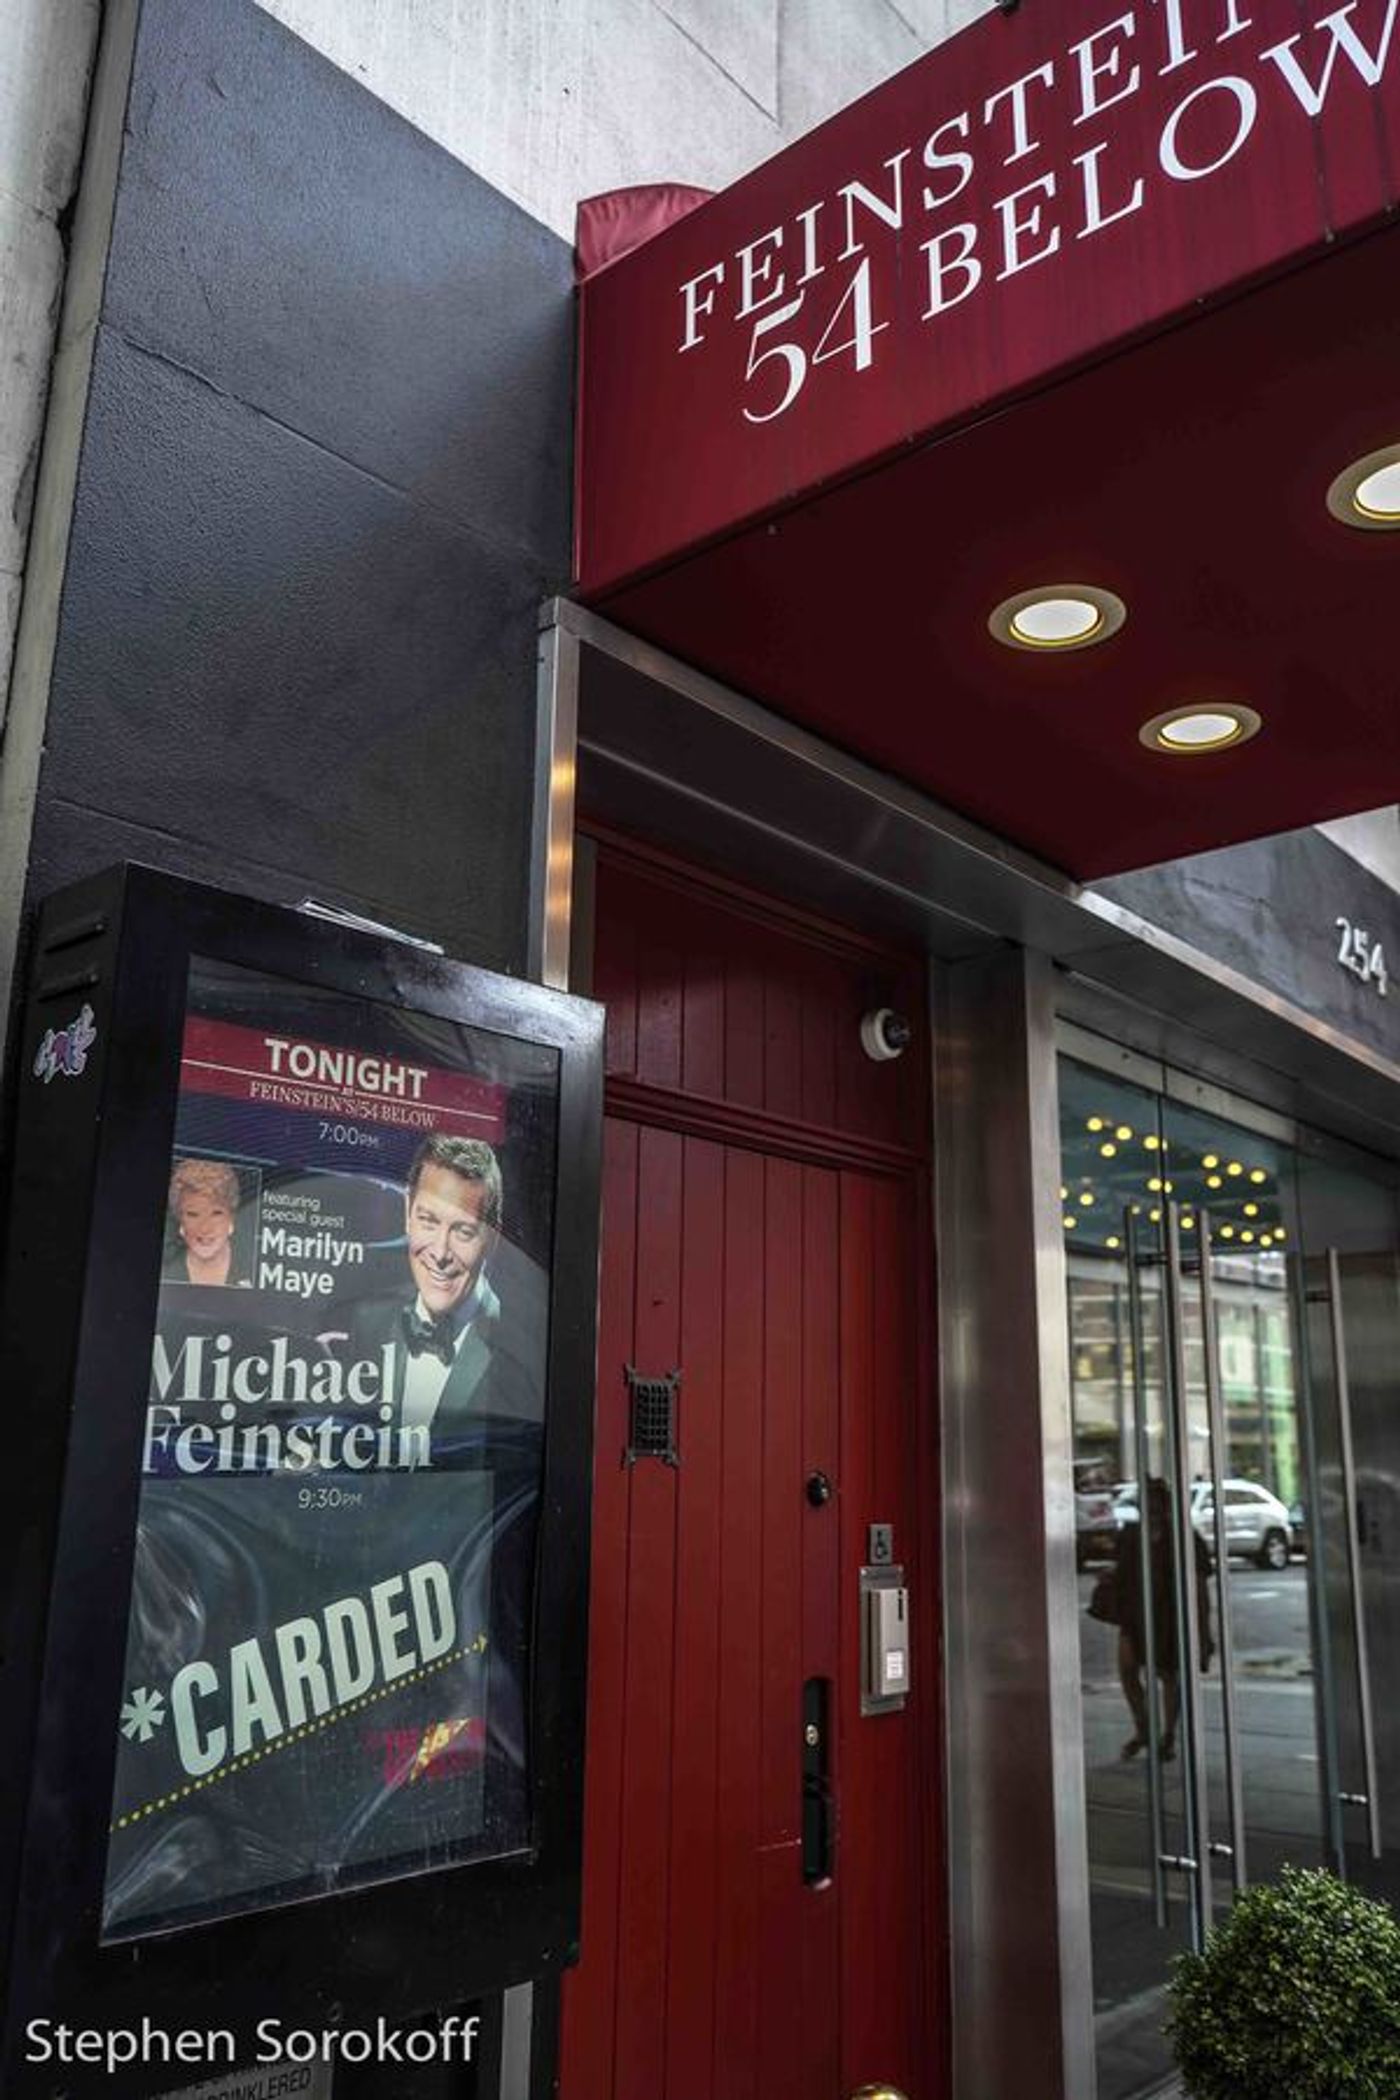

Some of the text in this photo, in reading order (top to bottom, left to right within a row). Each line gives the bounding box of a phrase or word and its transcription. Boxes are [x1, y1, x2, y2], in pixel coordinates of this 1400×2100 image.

[742, 0, 1400, 424] 54 BELOW
[1335, 916, 1387, 995] 254
[264, 1038, 428, 1098] TONIGHT
[381, 1105, 437, 1128] BELOW
[261, 1208, 345, 1229] special guest
[262, 1190, 321, 1212] featuring
[261, 1227, 364, 1267] Marilyn
[259, 1262, 335, 1299] Maye
[150, 1333, 396, 1403] Michael
[142, 1403, 434, 1474] Feinstein
